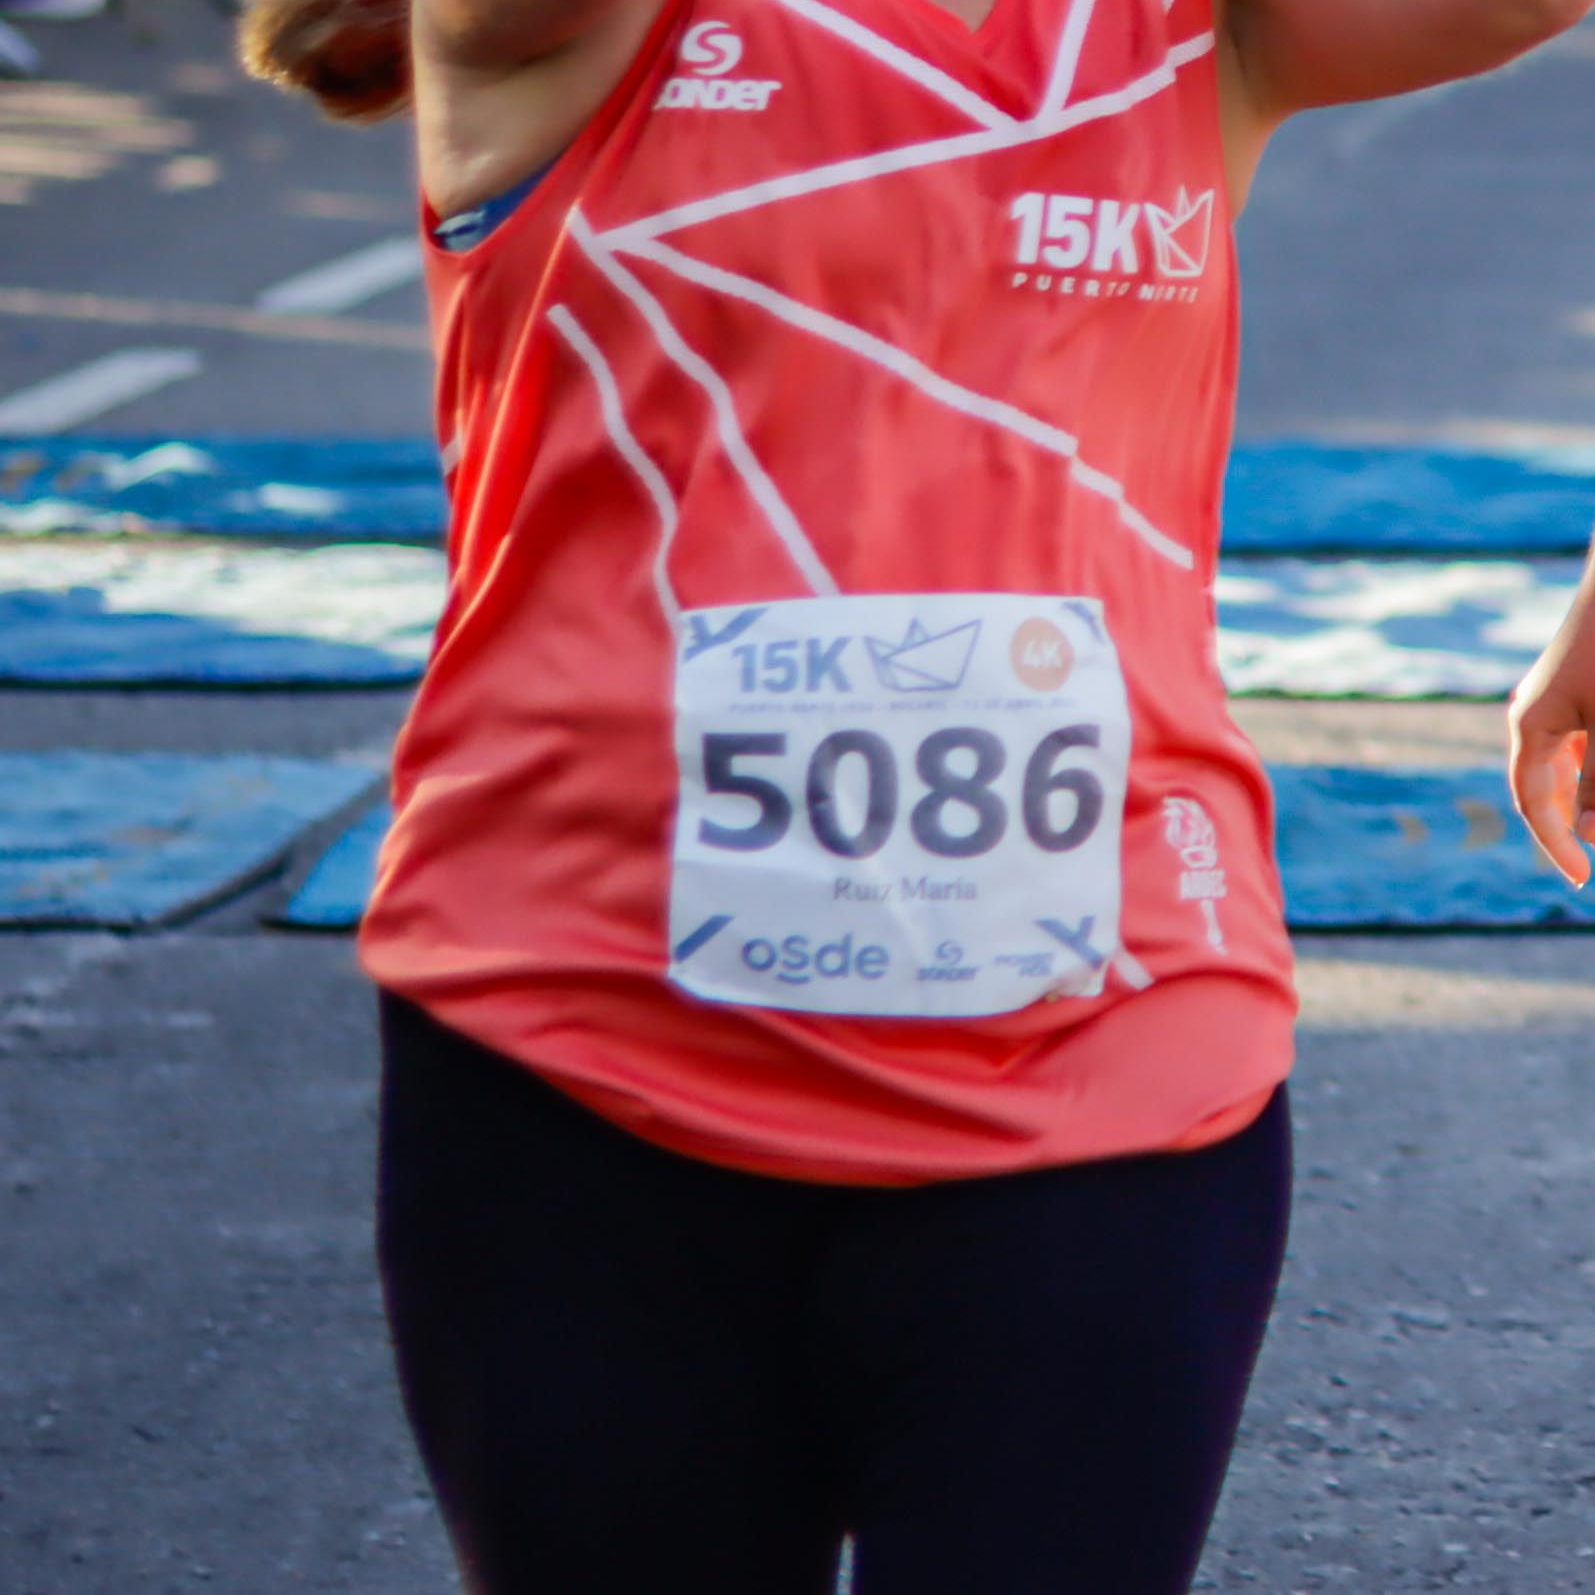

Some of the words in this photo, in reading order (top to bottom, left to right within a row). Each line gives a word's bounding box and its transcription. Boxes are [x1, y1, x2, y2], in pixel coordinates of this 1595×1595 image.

[1010, 192, 1139, 274] 15K
[1012, 272, 1130, 297] PUERTO
[729, 636, 853, 694] 15K
[1022, 641, 1063, 669] 4K
[697, 722, 1103, 860] 5086
[833, 877, 891, 901] Ruiz
[741, 930, 891, 981] osde
